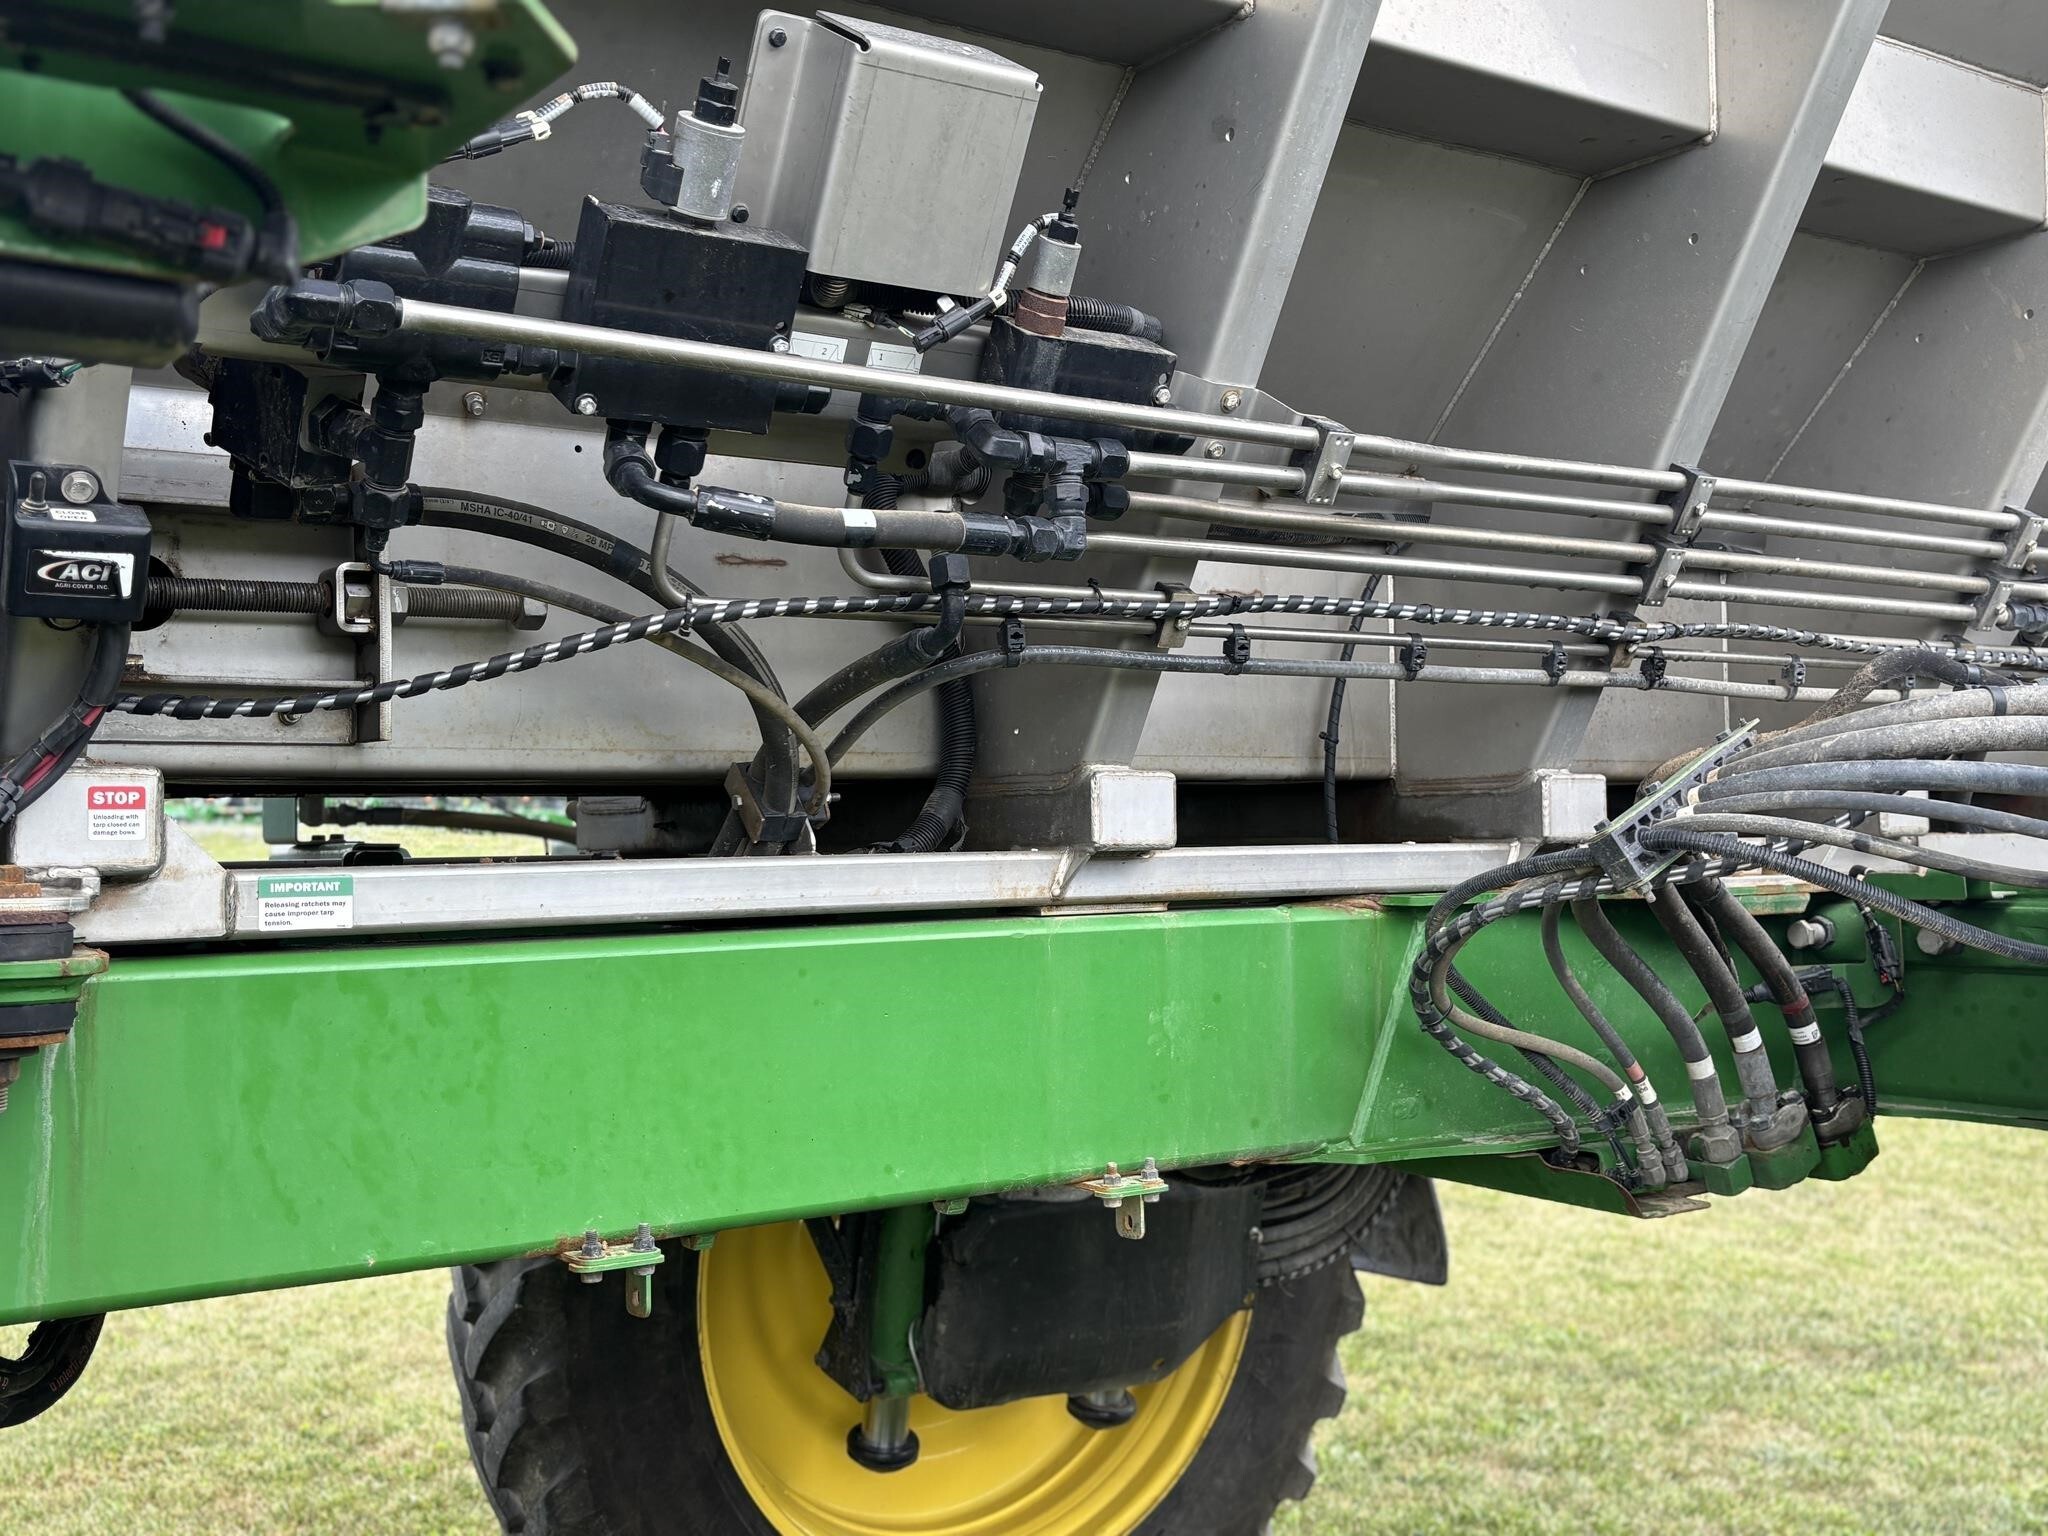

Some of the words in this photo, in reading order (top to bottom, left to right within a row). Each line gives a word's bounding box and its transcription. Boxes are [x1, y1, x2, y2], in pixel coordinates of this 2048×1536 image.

[821, 347, 828, 355] 2
[460, 501, 491, 515] MSHA
[494, 504, 533, 524] IC-40/41
[585, 534, 597, 546] 28
[599, 539, 615, 552] MP
[59, 564, 111, 581] ACI
[55, 582, 96, 590] AGRI-COVER,
[96, 583, 110, 591] INC.
[92, 791, 141, 805] STOP
[269, 881, 341, 893] IMPORTANT
[264, 901, 300, 909] Releasing
[264, 919, 293, 927] tension.
